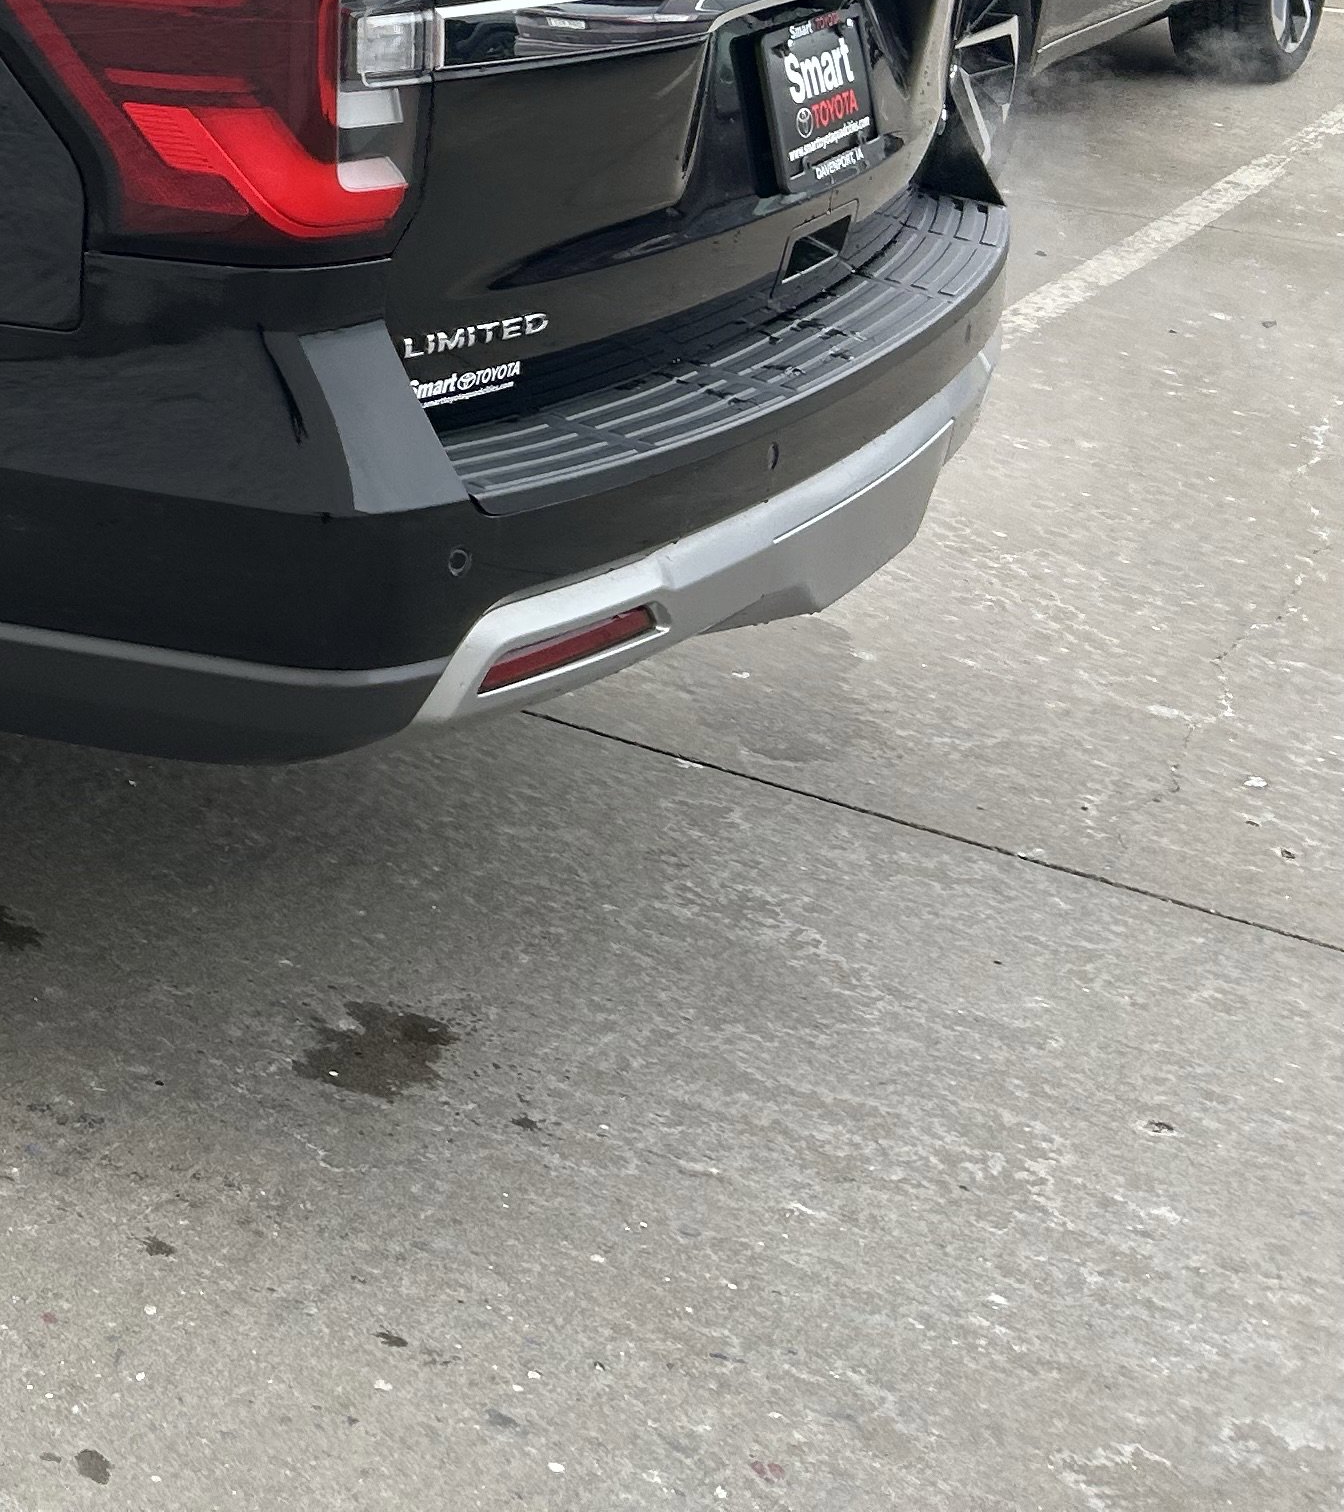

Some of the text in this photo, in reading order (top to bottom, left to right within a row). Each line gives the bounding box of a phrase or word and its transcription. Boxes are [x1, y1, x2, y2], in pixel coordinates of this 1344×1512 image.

[788, 20, 814, 40] Smart
[783, 37, 855, 104] Smart
[812, 88, 860, 129] TOYOTA
[402, 312, 550, 359] LIMITED
[409, 360, 521, 400] Smart TOYOTA
